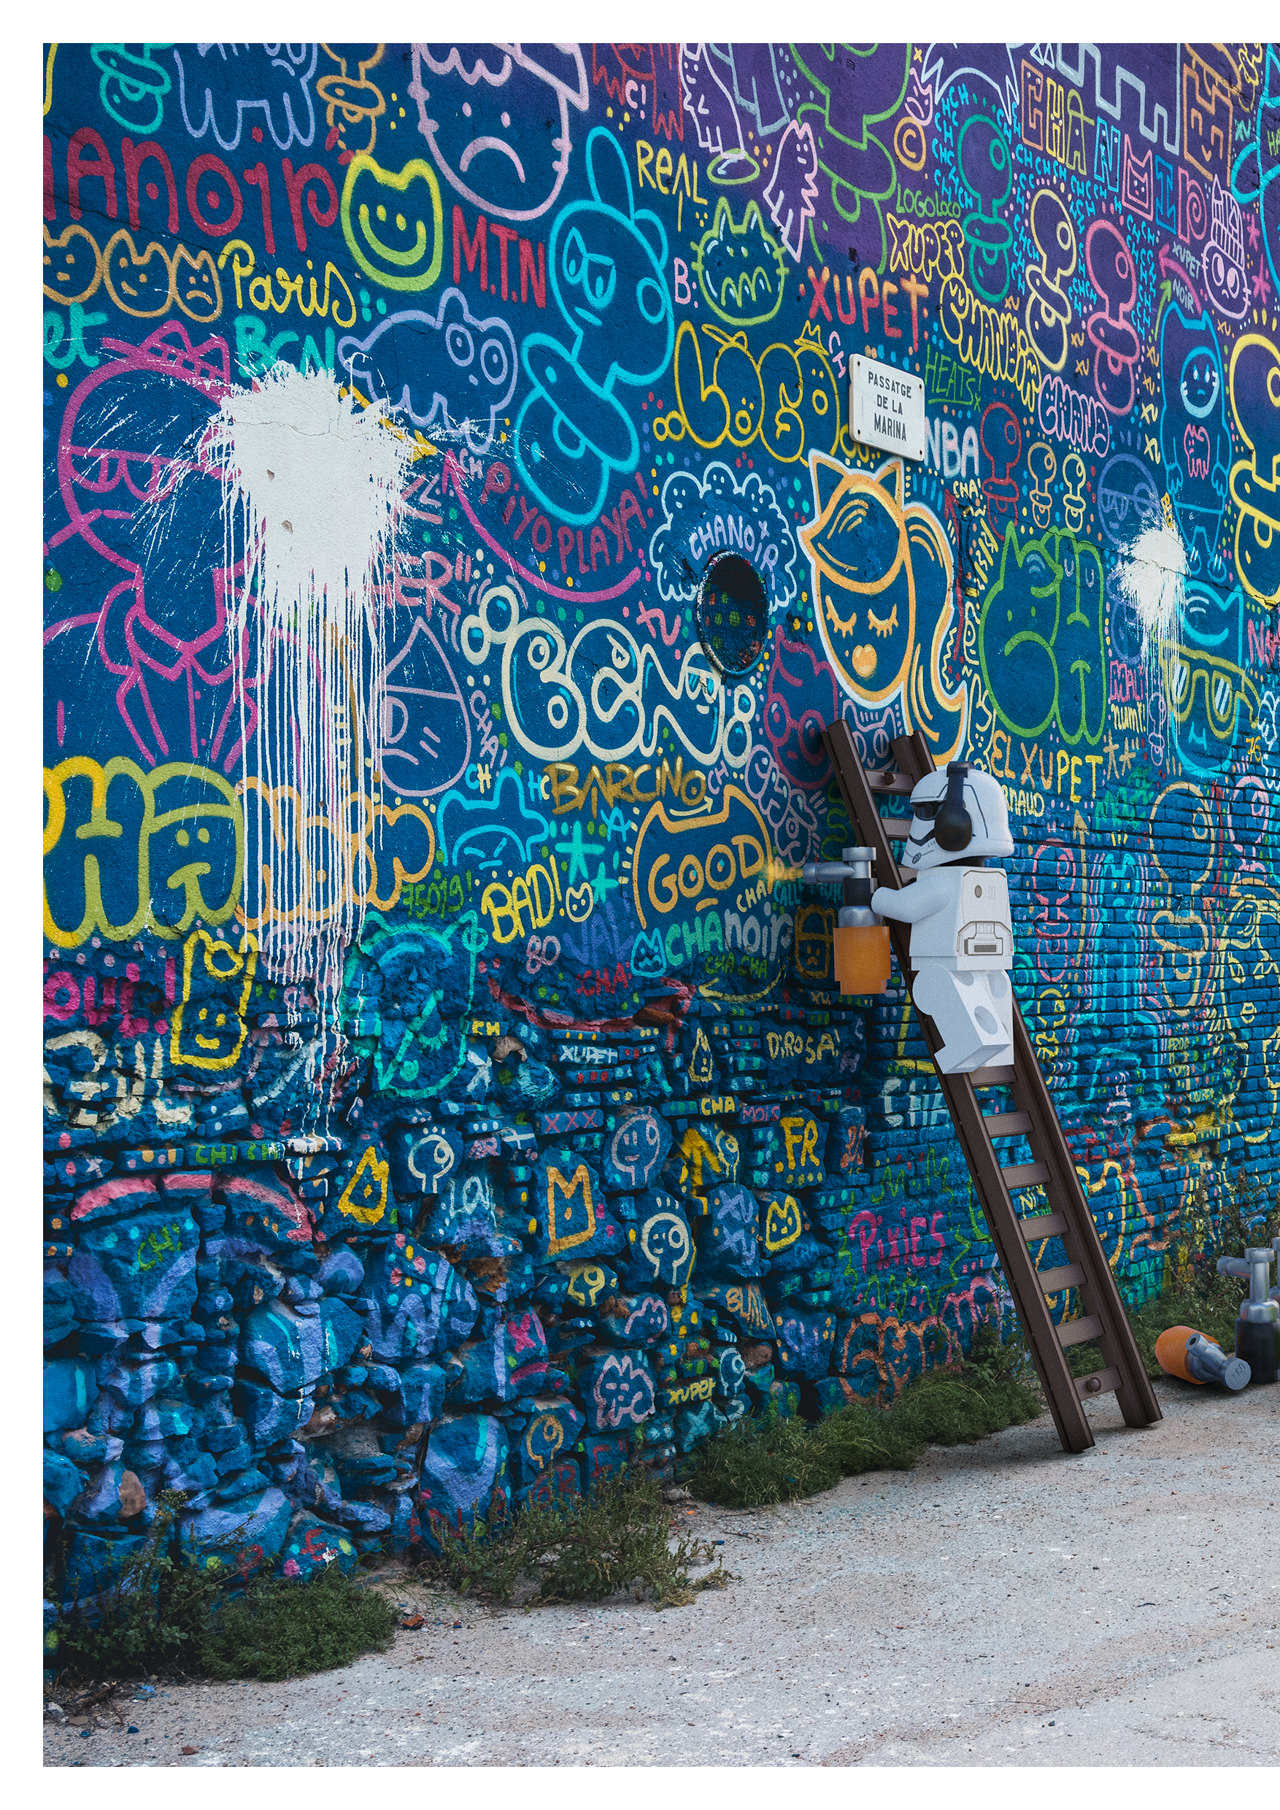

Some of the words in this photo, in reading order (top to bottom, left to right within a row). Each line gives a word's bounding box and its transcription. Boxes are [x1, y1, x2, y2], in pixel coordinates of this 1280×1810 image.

[217, 239, 357, 328] Paris
[806, 266, 930, 352] XUPET
[868, 371, 912, 399] PASSATGE
[876, 394, 889, 410] DE
[892, 400, 904, 415] LA
[874, 413, 907, 441] MARINA
[924, 416, 980, 479] NBA
[481, 855, 566, 943] BAD!
[648, 835, 765, 914] GOOD
[701, 1097, 736, 1117] CHA
